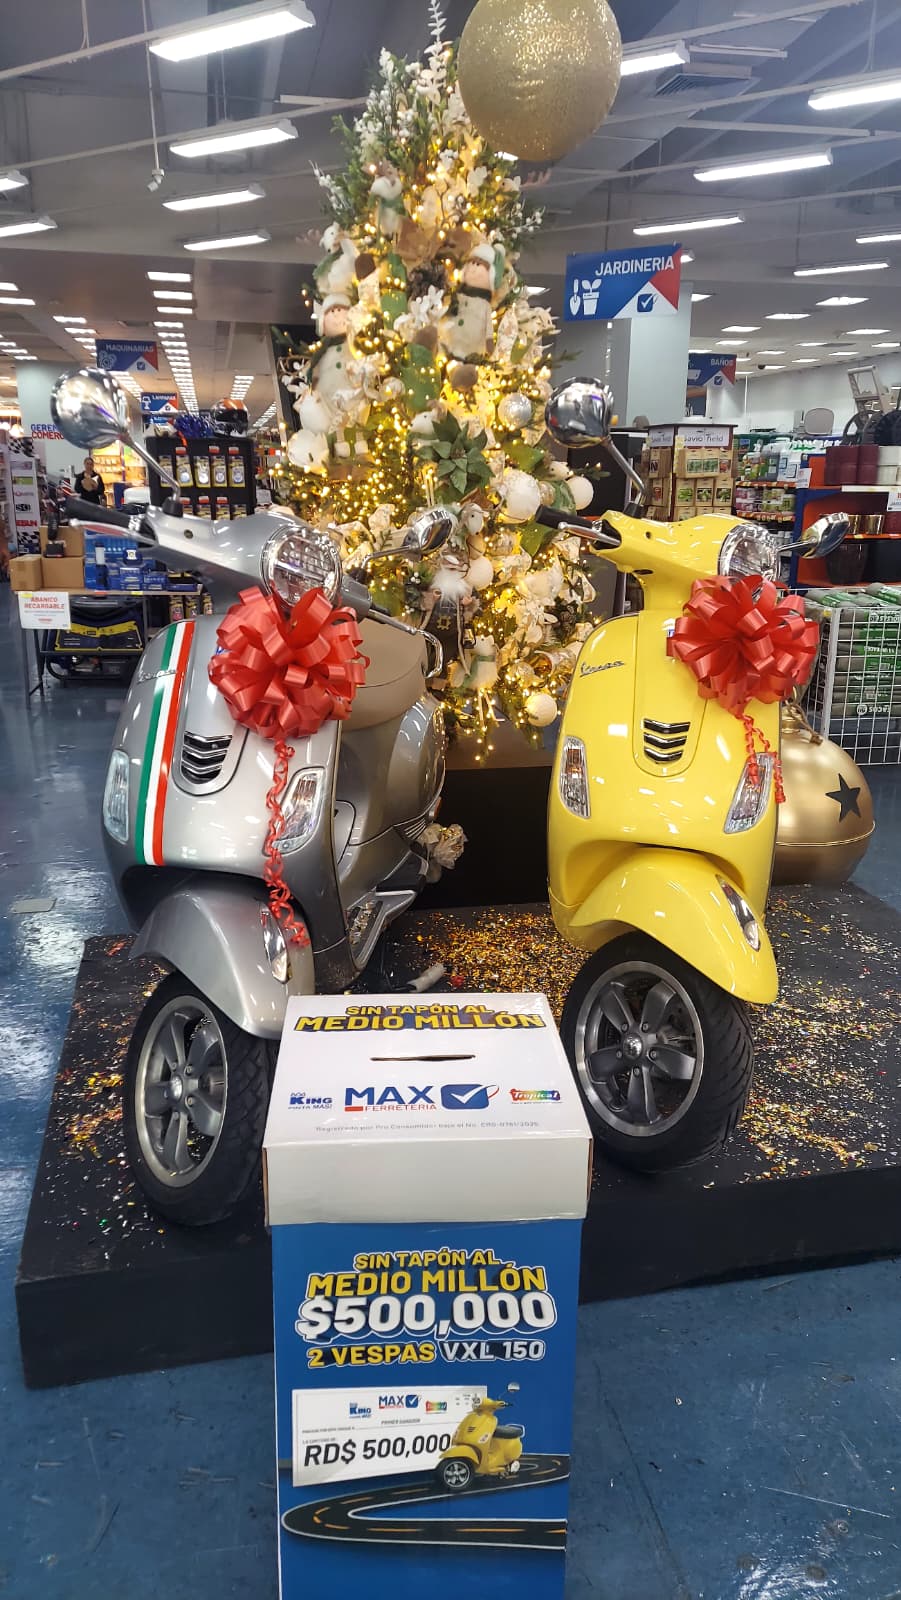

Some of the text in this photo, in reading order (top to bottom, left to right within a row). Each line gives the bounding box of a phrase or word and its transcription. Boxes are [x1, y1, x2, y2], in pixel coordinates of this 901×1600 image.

[595, 256, 674, 276] JARDINERIA
[106, 344, 153, 352] MAQUINARIAS
[346, 1003, 494, 1015] SIN TAPÓN AL
[296, 1011, 546, 1031] MEDIO MILLÓN
[290, 1097, 332, 1105] KING
[345, 1086, 435, 1105] MAX
[513, 1090, 560, 1101] Tropical
[365, 1104, 437, 1112] FERRETERIA
[355, 1249, 500, 1269] SIN TAPÓN AL
[308, 1262, 546, 1297] MEDIO MILLÓN
[299, 1291, 556, 1341] $500,000
[308, 1341, 544, 1367] 2 VESPAS VXL 150
[379, 1395, 404, 1406] MAX
[303, 1433, 451, 1467] RD$ 500,000
